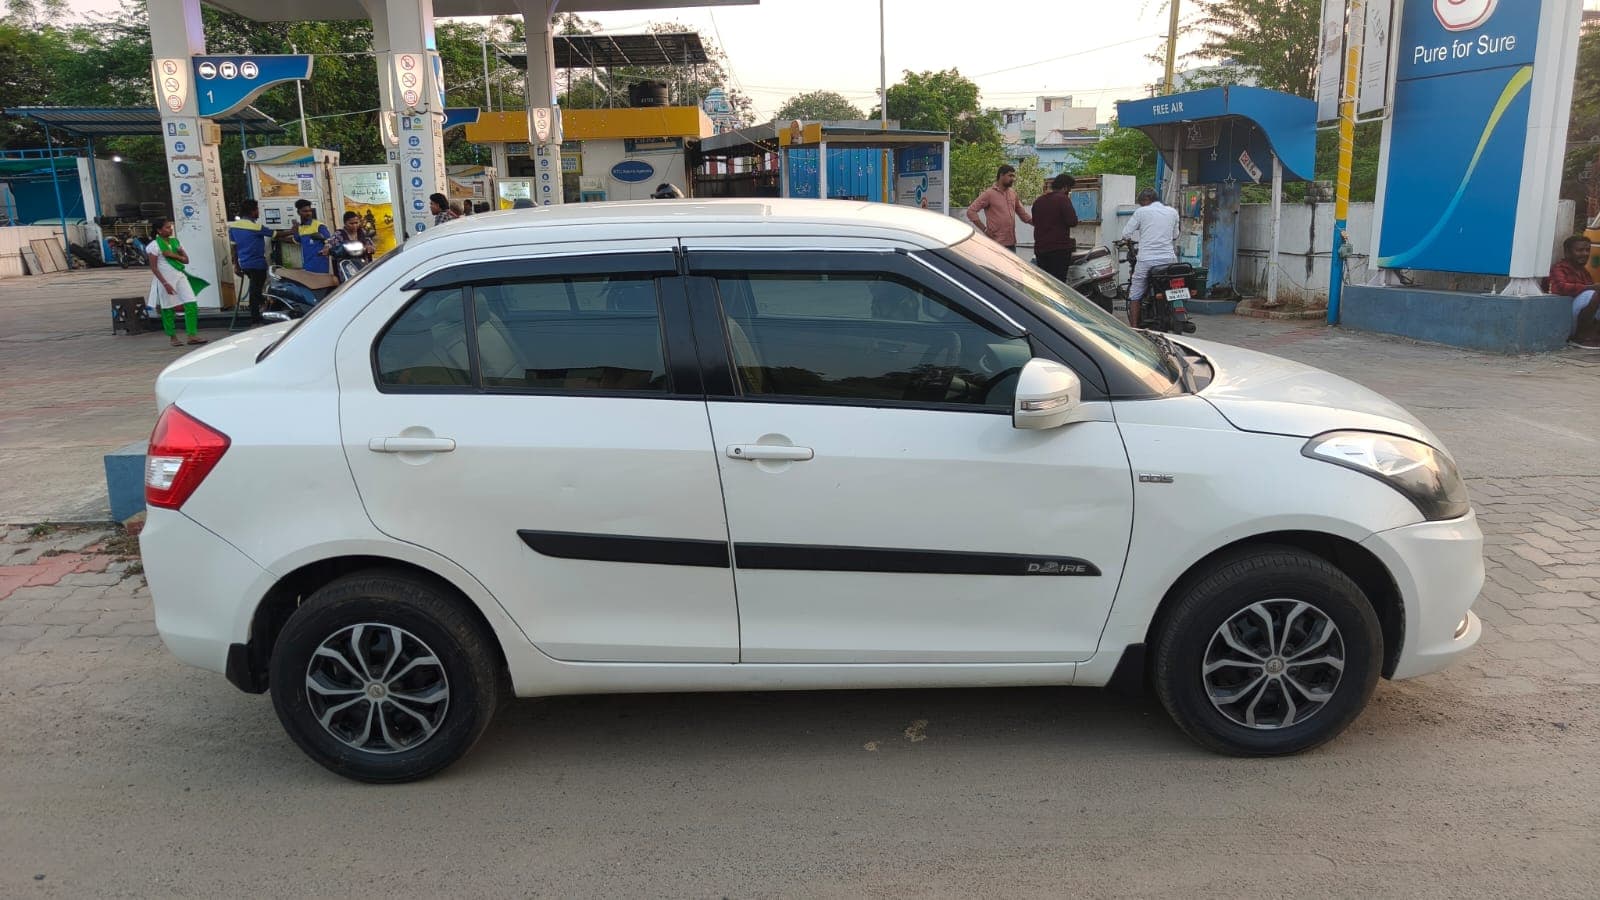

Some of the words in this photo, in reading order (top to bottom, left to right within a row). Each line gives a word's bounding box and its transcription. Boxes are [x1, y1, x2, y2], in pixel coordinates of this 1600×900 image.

[1413, 46, 1448, 64] Pure
[1452, 40, 1473, 59] for
[1477, 34, 1516, 55] Sure
[206, 90, 214, 104] 1
[1152, 103, 1169, 116] FREE
[1171, 101, 1184, 114] AIR
